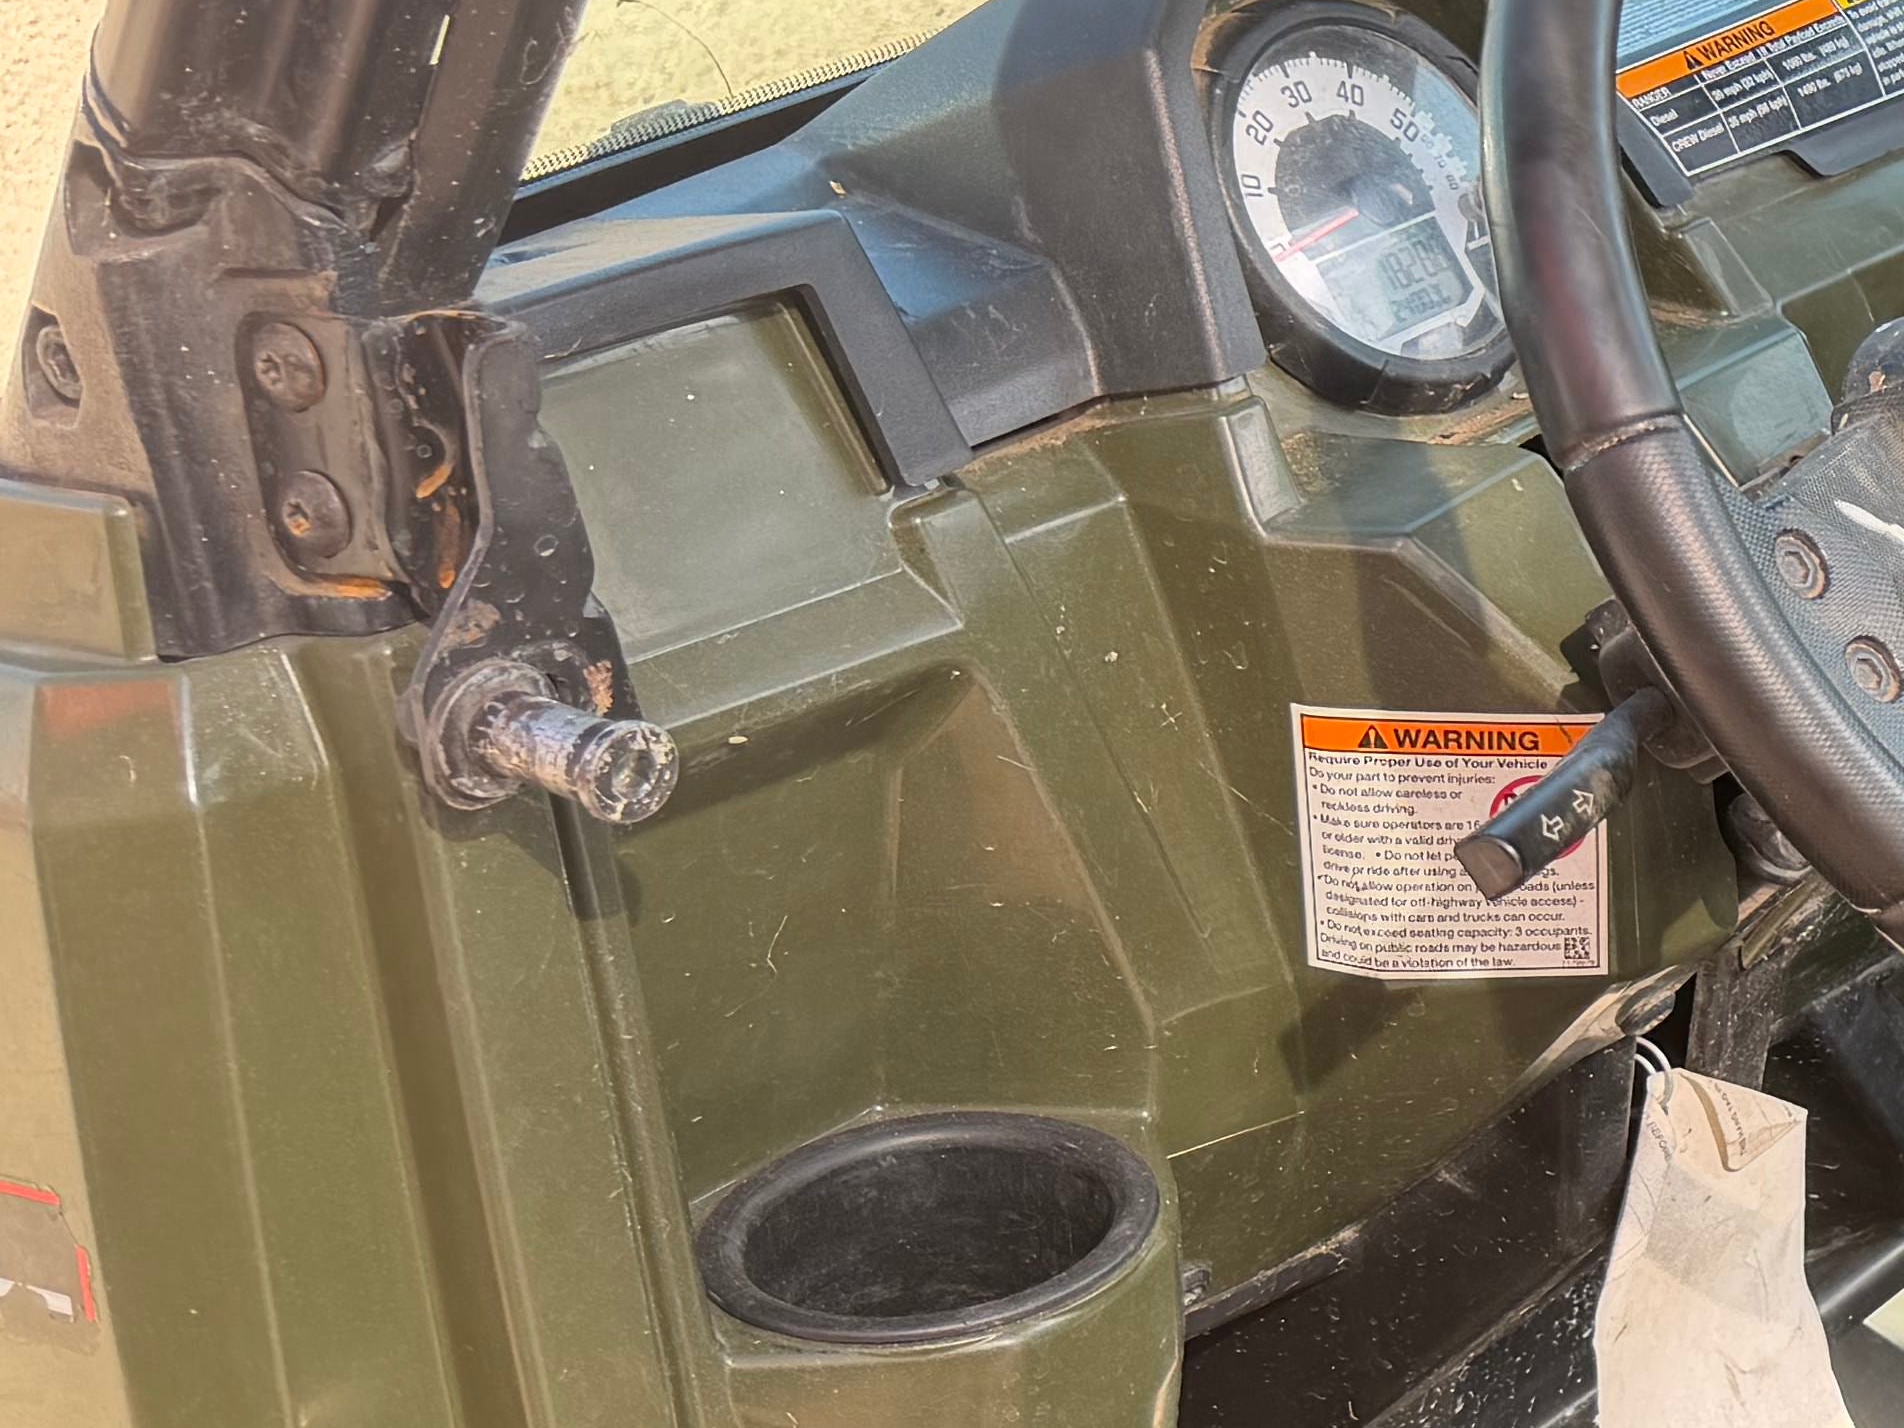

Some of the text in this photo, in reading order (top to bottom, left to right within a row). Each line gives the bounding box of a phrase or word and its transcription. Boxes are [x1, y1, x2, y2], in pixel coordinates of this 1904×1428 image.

[1696, 20, 1776, 66] WARNING
[1281, 80, 1313, 109] 30
[1336, 80, 1365, 108] 40
[1390, 108, 1421, 143] 50
[1650, 108, 1680, 127] Diesel
[1246, 110, 1274, 146] 20
[1698, 122, 1726, 143] Diesel
[1240, 173, 1264, 199] 10
[1393, 728, 1540, 751] WARNING
[1308, 752, 1549, 770] Require Proper Use of Your Vehicle
[1309, 767, 1496, 786] Do your part to prevent injuries:
[1320, 783, 1463, 800] Do not allow careless or
[1321, 801, 1418, 817] reckless driving.
[1320, 813, 1481, 832] Make sure operators are 16
[1322, 830, 1333, 841] or
[1334, 832, 1365, 844] older
[1367, 834, 1393, 845] with
[1395, 836, 1402, 845] a
[1405, 834, 1434, 845] valid
[1323, 845, 1365, 860] license.
[1384, 850, 1402, 861] Do
[1404, 851, 1424, 861] not
[1426, 850, 1441, 861] let
[1323, 861, 1351, 874] drive
[1367, 867, 1391, 876] ride
[1393, 867, 1420, 876] after
[1423, 866, 1457, 878] using
[1324, 875, 1339, 886] Do
[1342, 880, 1359, 891] not
[1361, 882, 1393, 892] allow
[1396, 883, 1455, 894] operation
[1457, 884, 1473, 892] on
[1520, 882, 1550, 892] oads
[1552, 881, 1595, 893] (unless
[1326, 891, 1389, 907] designated
[1391, 897, 1407, 908] for
[1410, 896, 1483, 909] off-highway
[1530, 896, 1578, 909] access)
[1326, 905, 1566, 923] collisions with cars and trucks can occur.
[1327, 919, 1593, 939] Do not exceed seating capacity: 3 occupants.
[1320, 933, 1562, 954] Driving on public roads may be hazardous
[1321, 949, 1516, 968] and could be a violation of the law.
